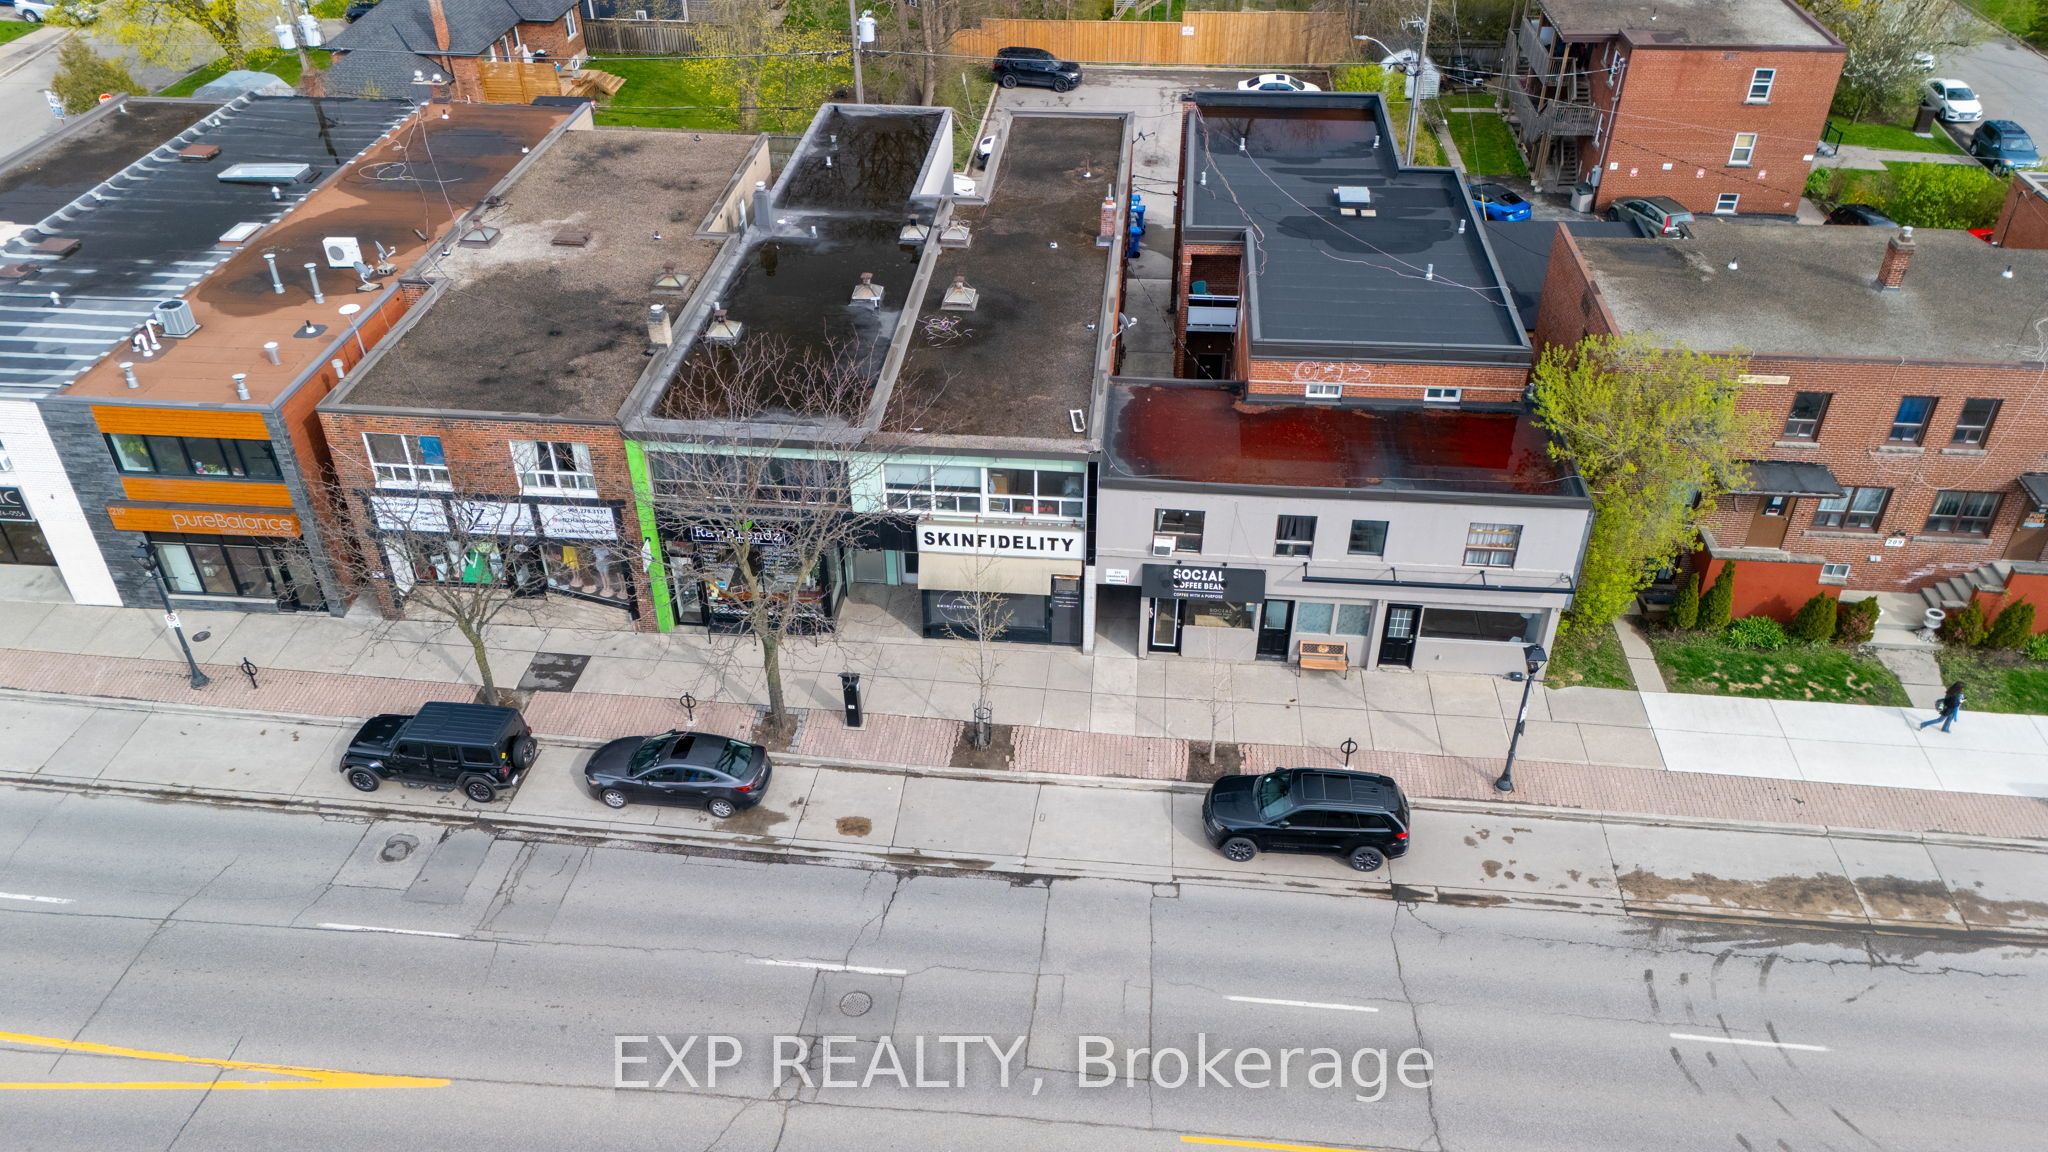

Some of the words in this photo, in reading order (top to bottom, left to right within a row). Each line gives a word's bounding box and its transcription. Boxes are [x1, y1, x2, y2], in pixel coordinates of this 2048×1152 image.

[171, 513, 293, 531] pureBalance
[923, 531, 1075, 552] SKINFIDELITY
[1172, 568, 1225, 582] SOCIAL
